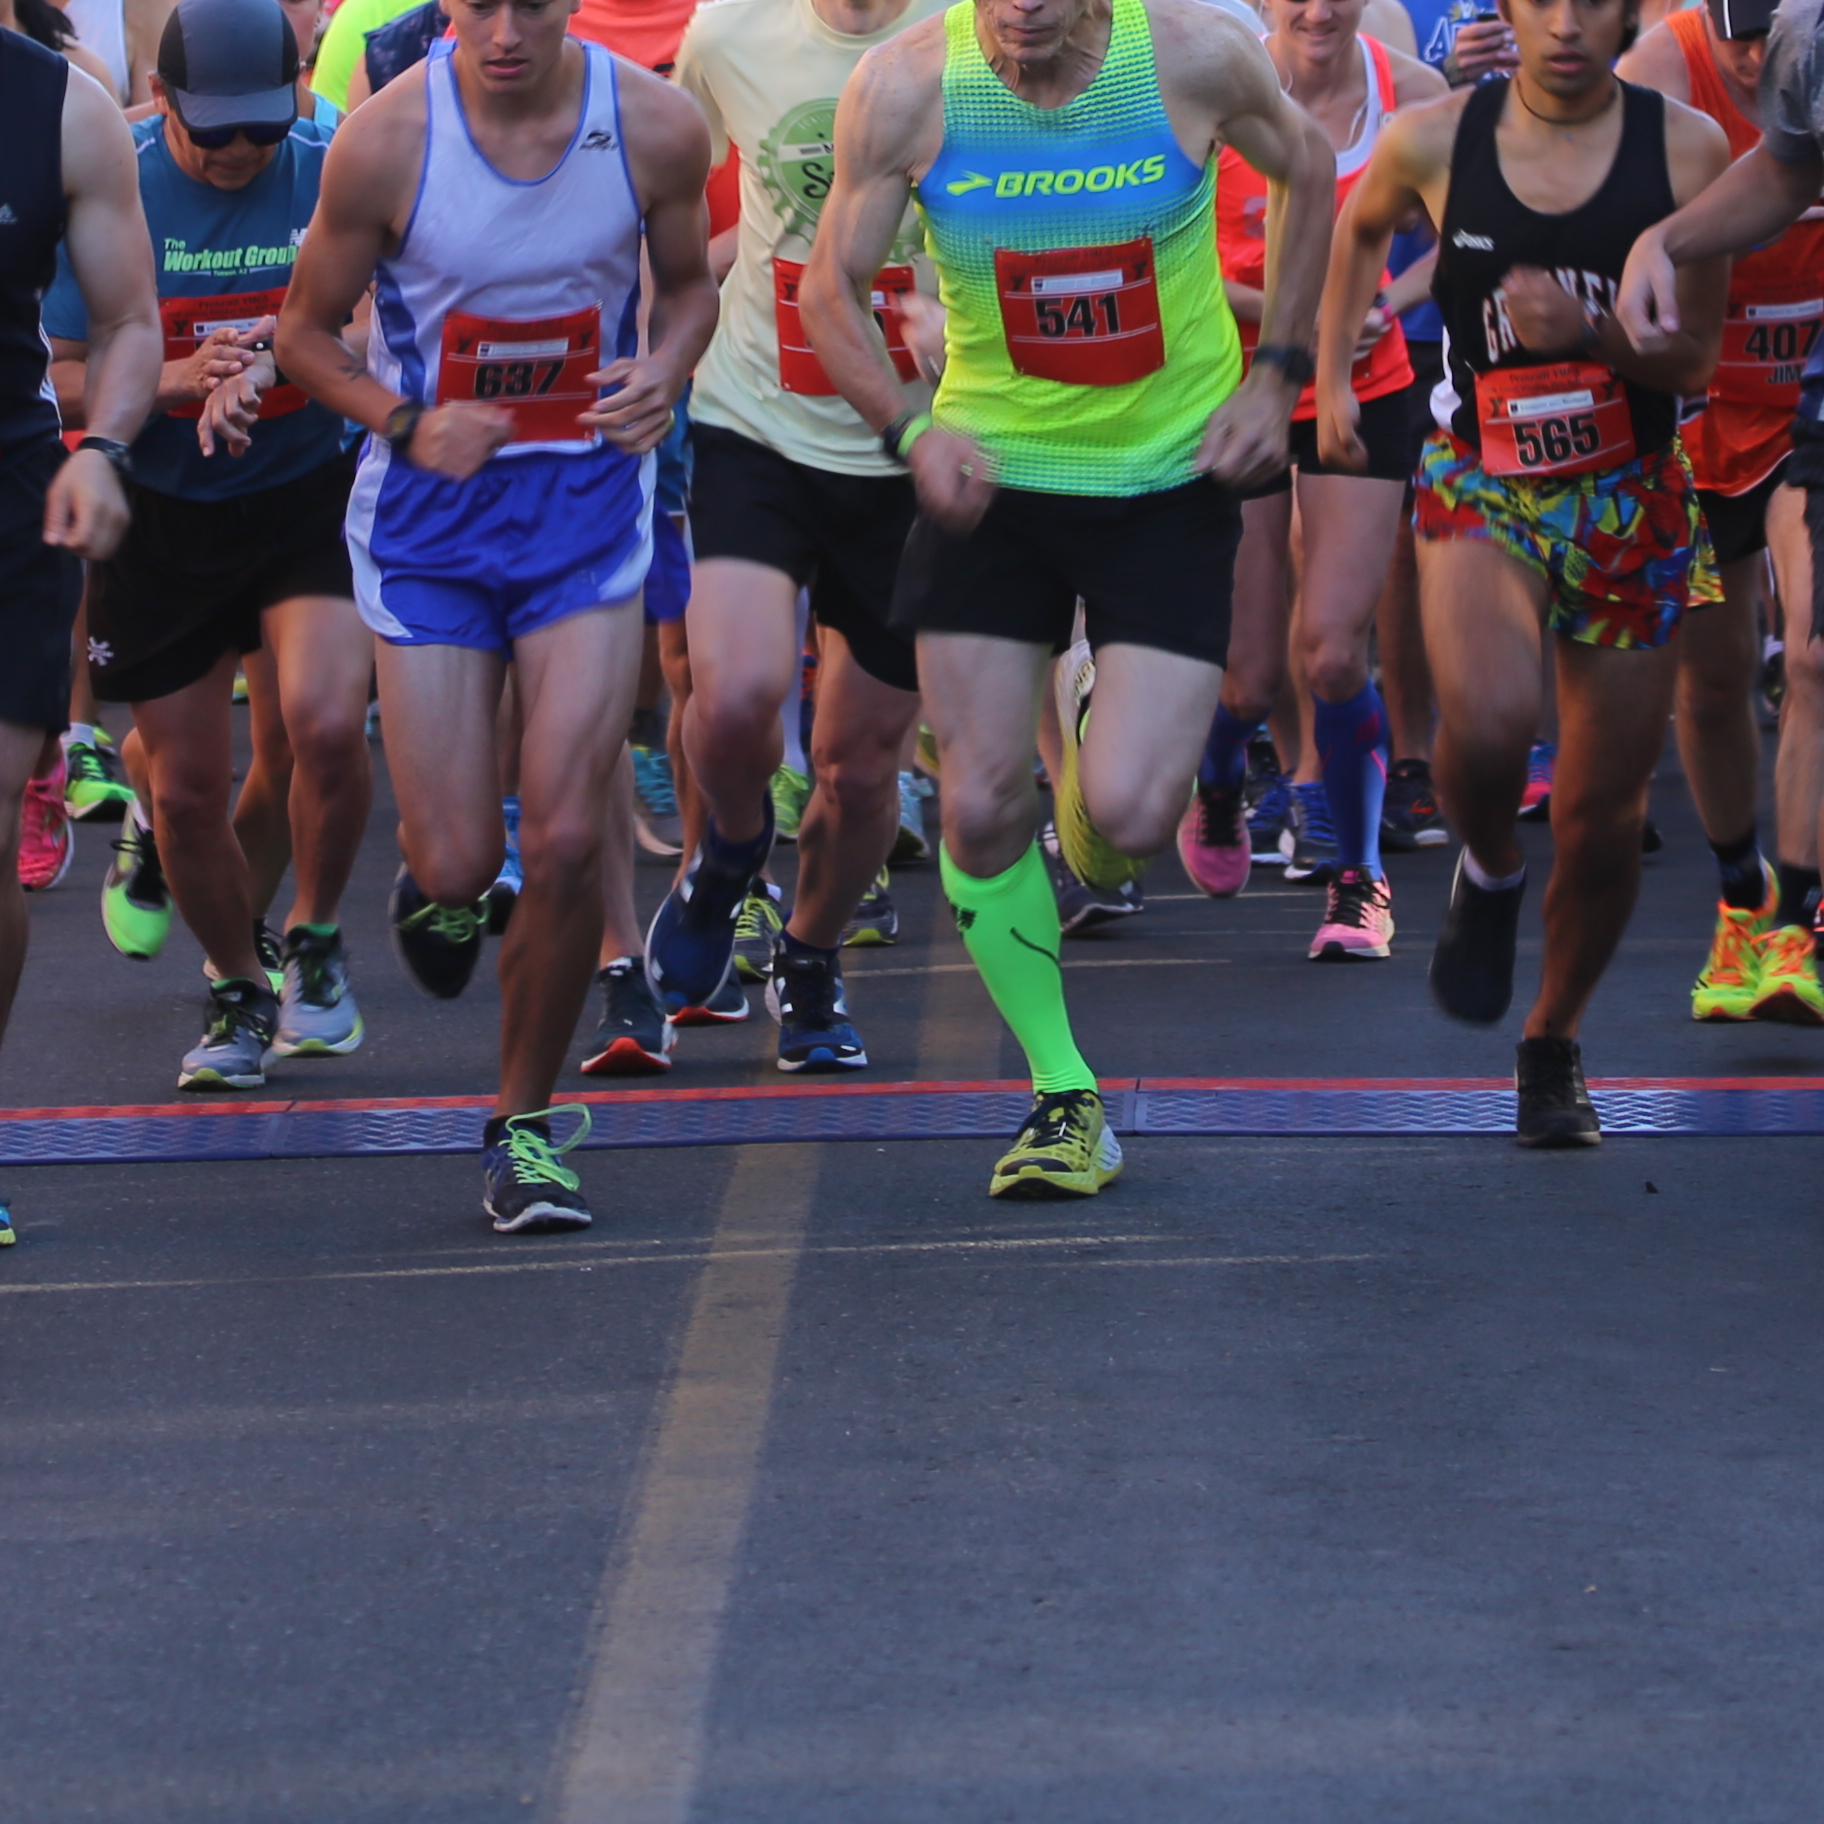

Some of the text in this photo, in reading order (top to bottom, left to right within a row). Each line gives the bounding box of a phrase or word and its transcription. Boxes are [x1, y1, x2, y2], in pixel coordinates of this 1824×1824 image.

[995, 154, 1166, 199] BROOKS
[163, 244, 300, 272] Workout Group
[164, 238, 187, 251] The
[1035, 292, 1122, 340] 541
[1745, 319, 1822, 363] 407
[475, 358, 567, 400] 637
[1512, 412, 1601, 467] 565
